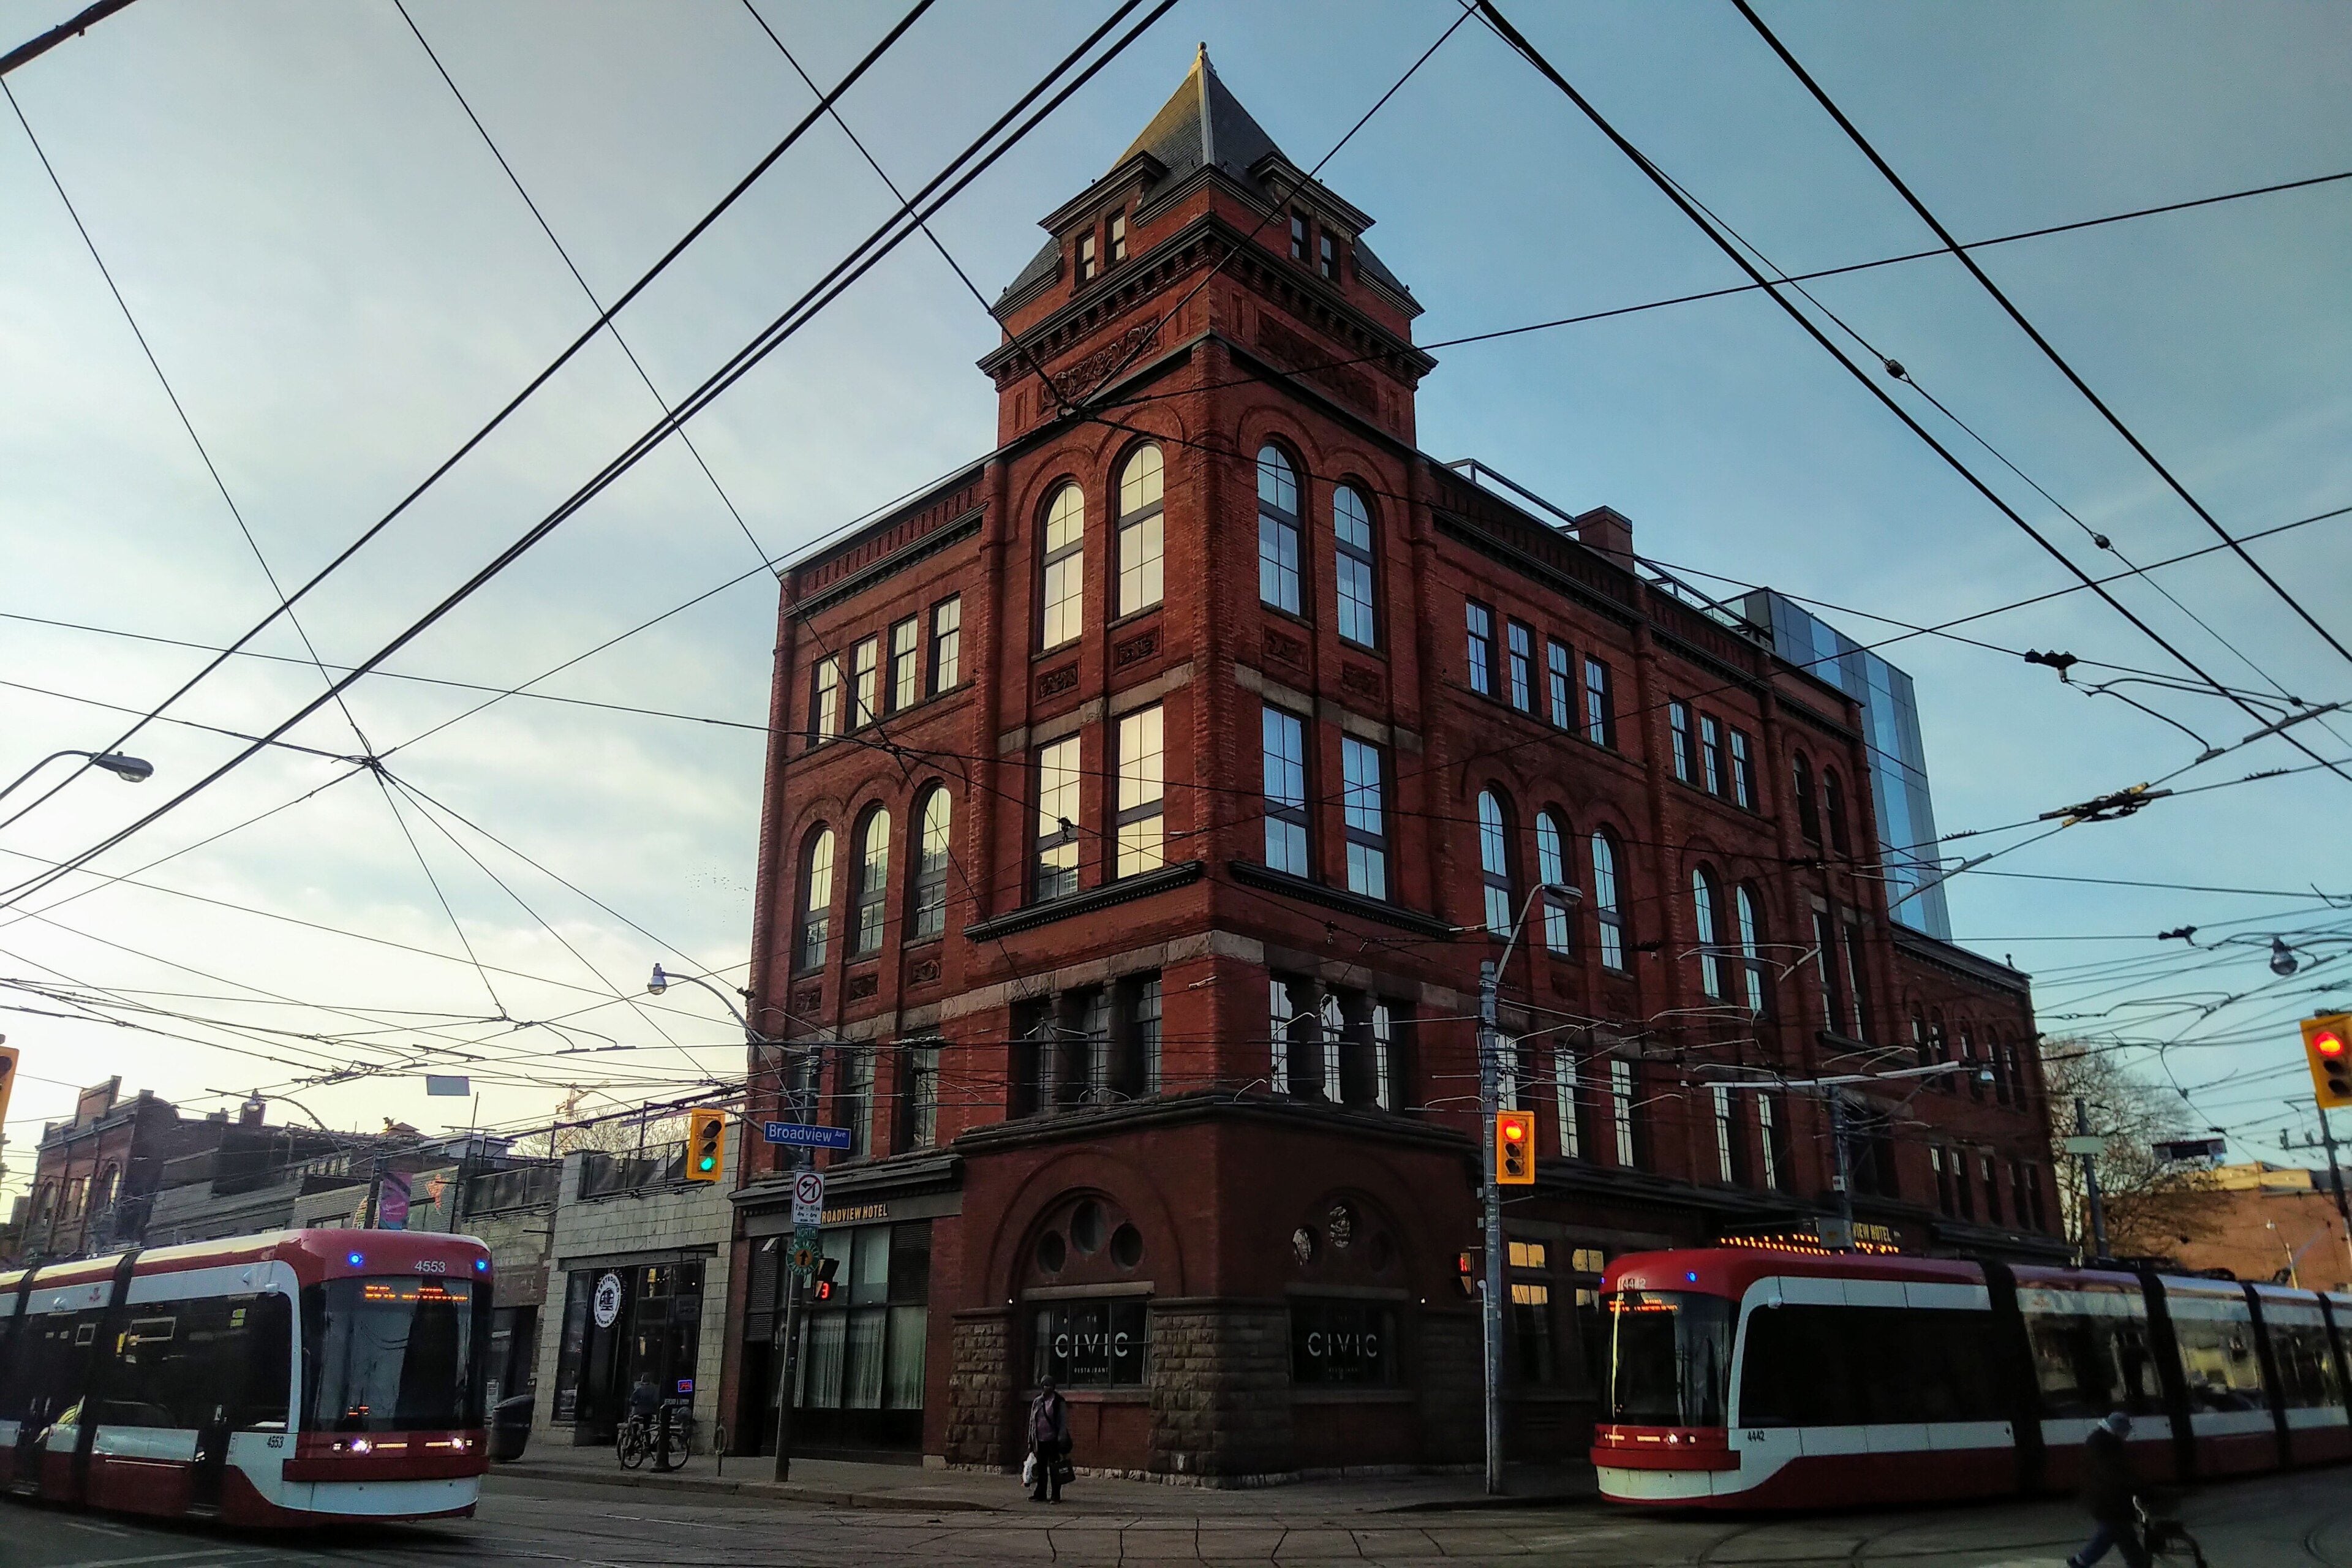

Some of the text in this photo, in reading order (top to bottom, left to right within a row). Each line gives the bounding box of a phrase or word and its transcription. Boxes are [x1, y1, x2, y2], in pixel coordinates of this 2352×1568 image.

[769, 1124, 832, 1142] Broadview
[822, 1204, 888, 1224] ROADVIEW HOTEL
[797, 1227, 816, 1237] NORTH
[1852, 1222, 1869, 1240] VIEW
[1870, 1224, 1892, 1242] HOTEL
[415, 1261, 446, 1273] 4553
[821, 1283, 829, 1298] 3
[1055, 1332, 1128, 1358] CIVIC
[1308, 1332, 1378, 1358] CIVIC
[267, 1436, 284, 1449] 4553
[1747, 1430, 1765, 1442] 4442
